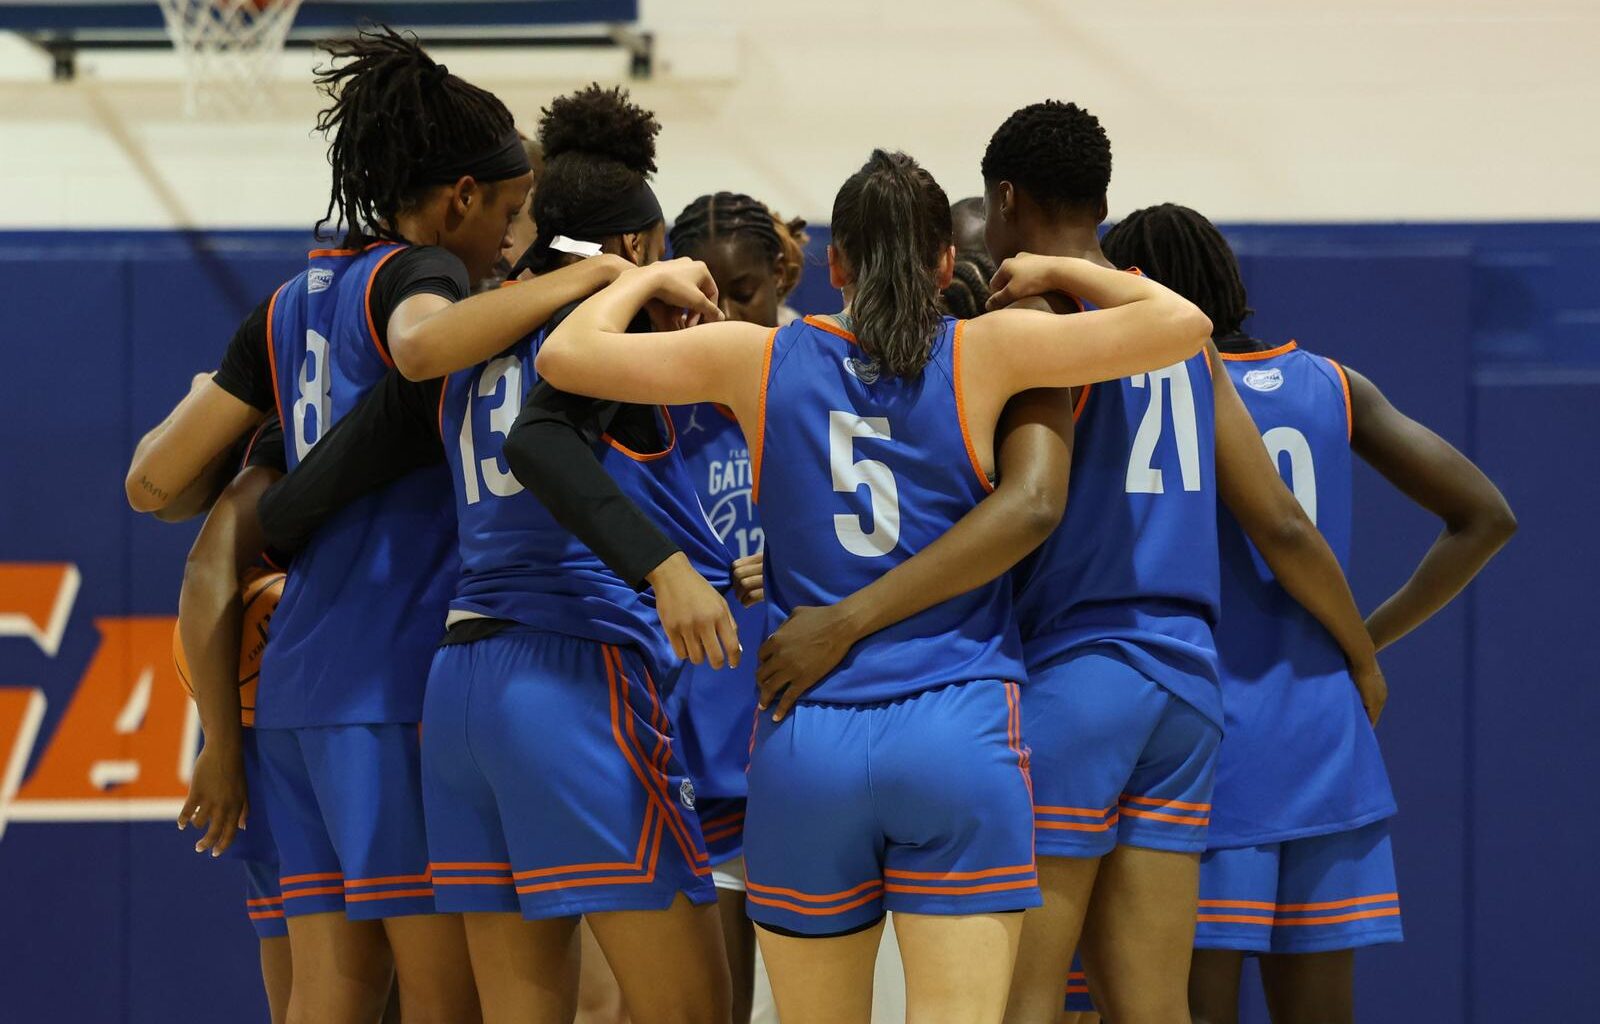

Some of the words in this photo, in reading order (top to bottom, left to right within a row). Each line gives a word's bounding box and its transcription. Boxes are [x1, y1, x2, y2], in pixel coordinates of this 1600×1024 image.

[293, 329, 332, 462] 8
[459, 354, 527, 505] 13
[1125, 361, 1200, 494] 21
[735, 527, 766, 559] 12
[829, 410, 900, 557] 5
